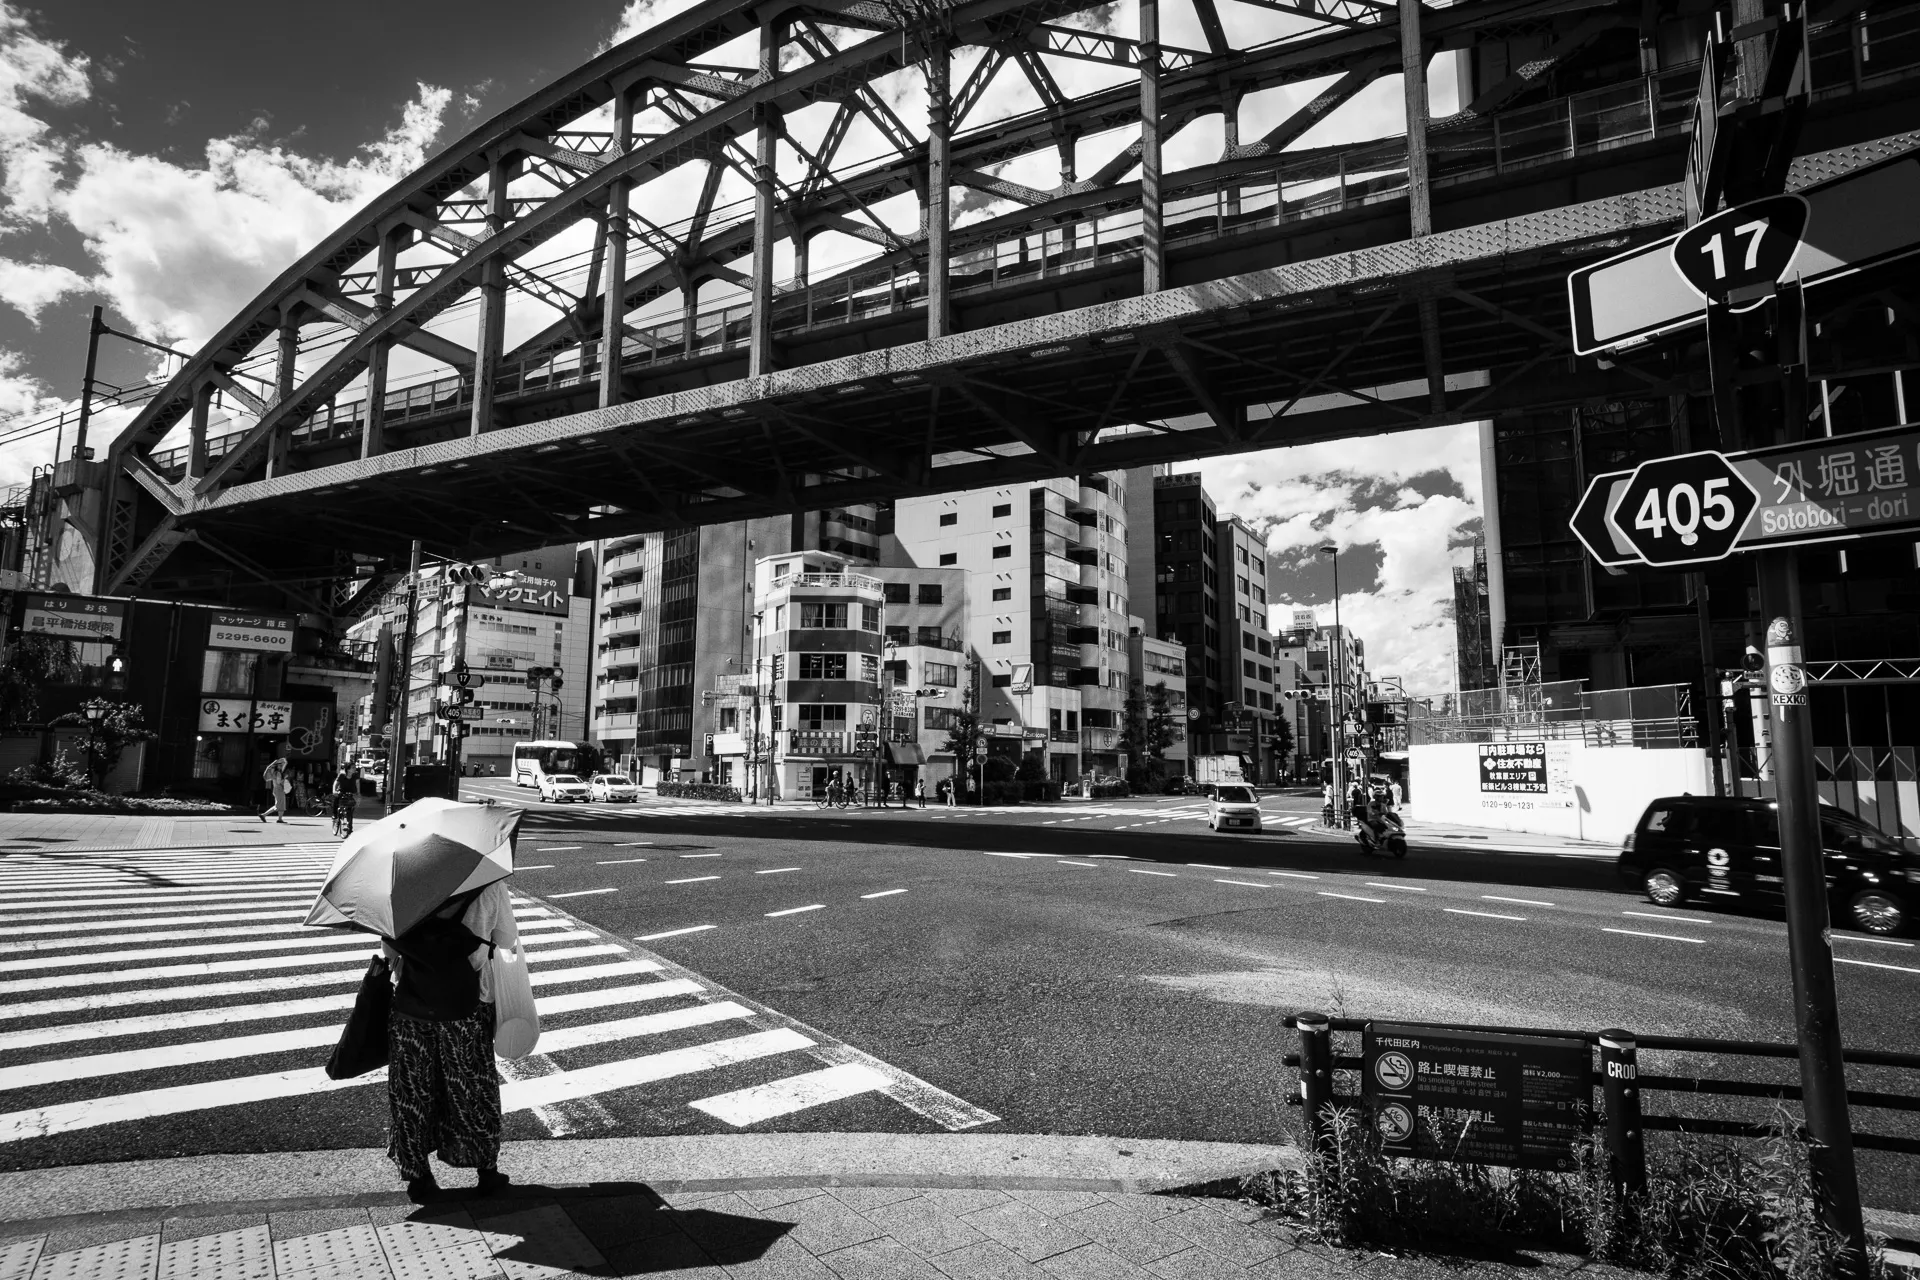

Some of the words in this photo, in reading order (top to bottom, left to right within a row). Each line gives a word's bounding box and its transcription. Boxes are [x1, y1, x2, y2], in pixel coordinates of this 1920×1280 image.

[1701, 220, 1770, 280] 17
[1773, 443, 1920, 504] 外堀通
[1634, 477, 1735, 538] 405
[219, 616, 261, 626] マッサージ
[216, 632, 287, 645] 5295-6600
[459, 674, 468, 683] 17
[1773, 695, 1806, 705] KEXKO
[447, 708, 460, 716] 405
[217, 710, 284, 731] まぐろ亭
[706, 735, 713, 745] P
[1480, 744, 1545, 756] 屋内駐車場なら
[1497, 758, 1542, 769] 住友不動産
[1481, 800, 1534, 809] 0120-90-1231
[1375, 1037, 1420, 1049] 千代田区内
[1418, 1061, 1496, 1080] 路上喫煙禁止
[1607, 1060, 1636, 1080] CROD
[1427, 1076, 1455, 1086] smoking
[1465, 1079, 1477, 1087] the
